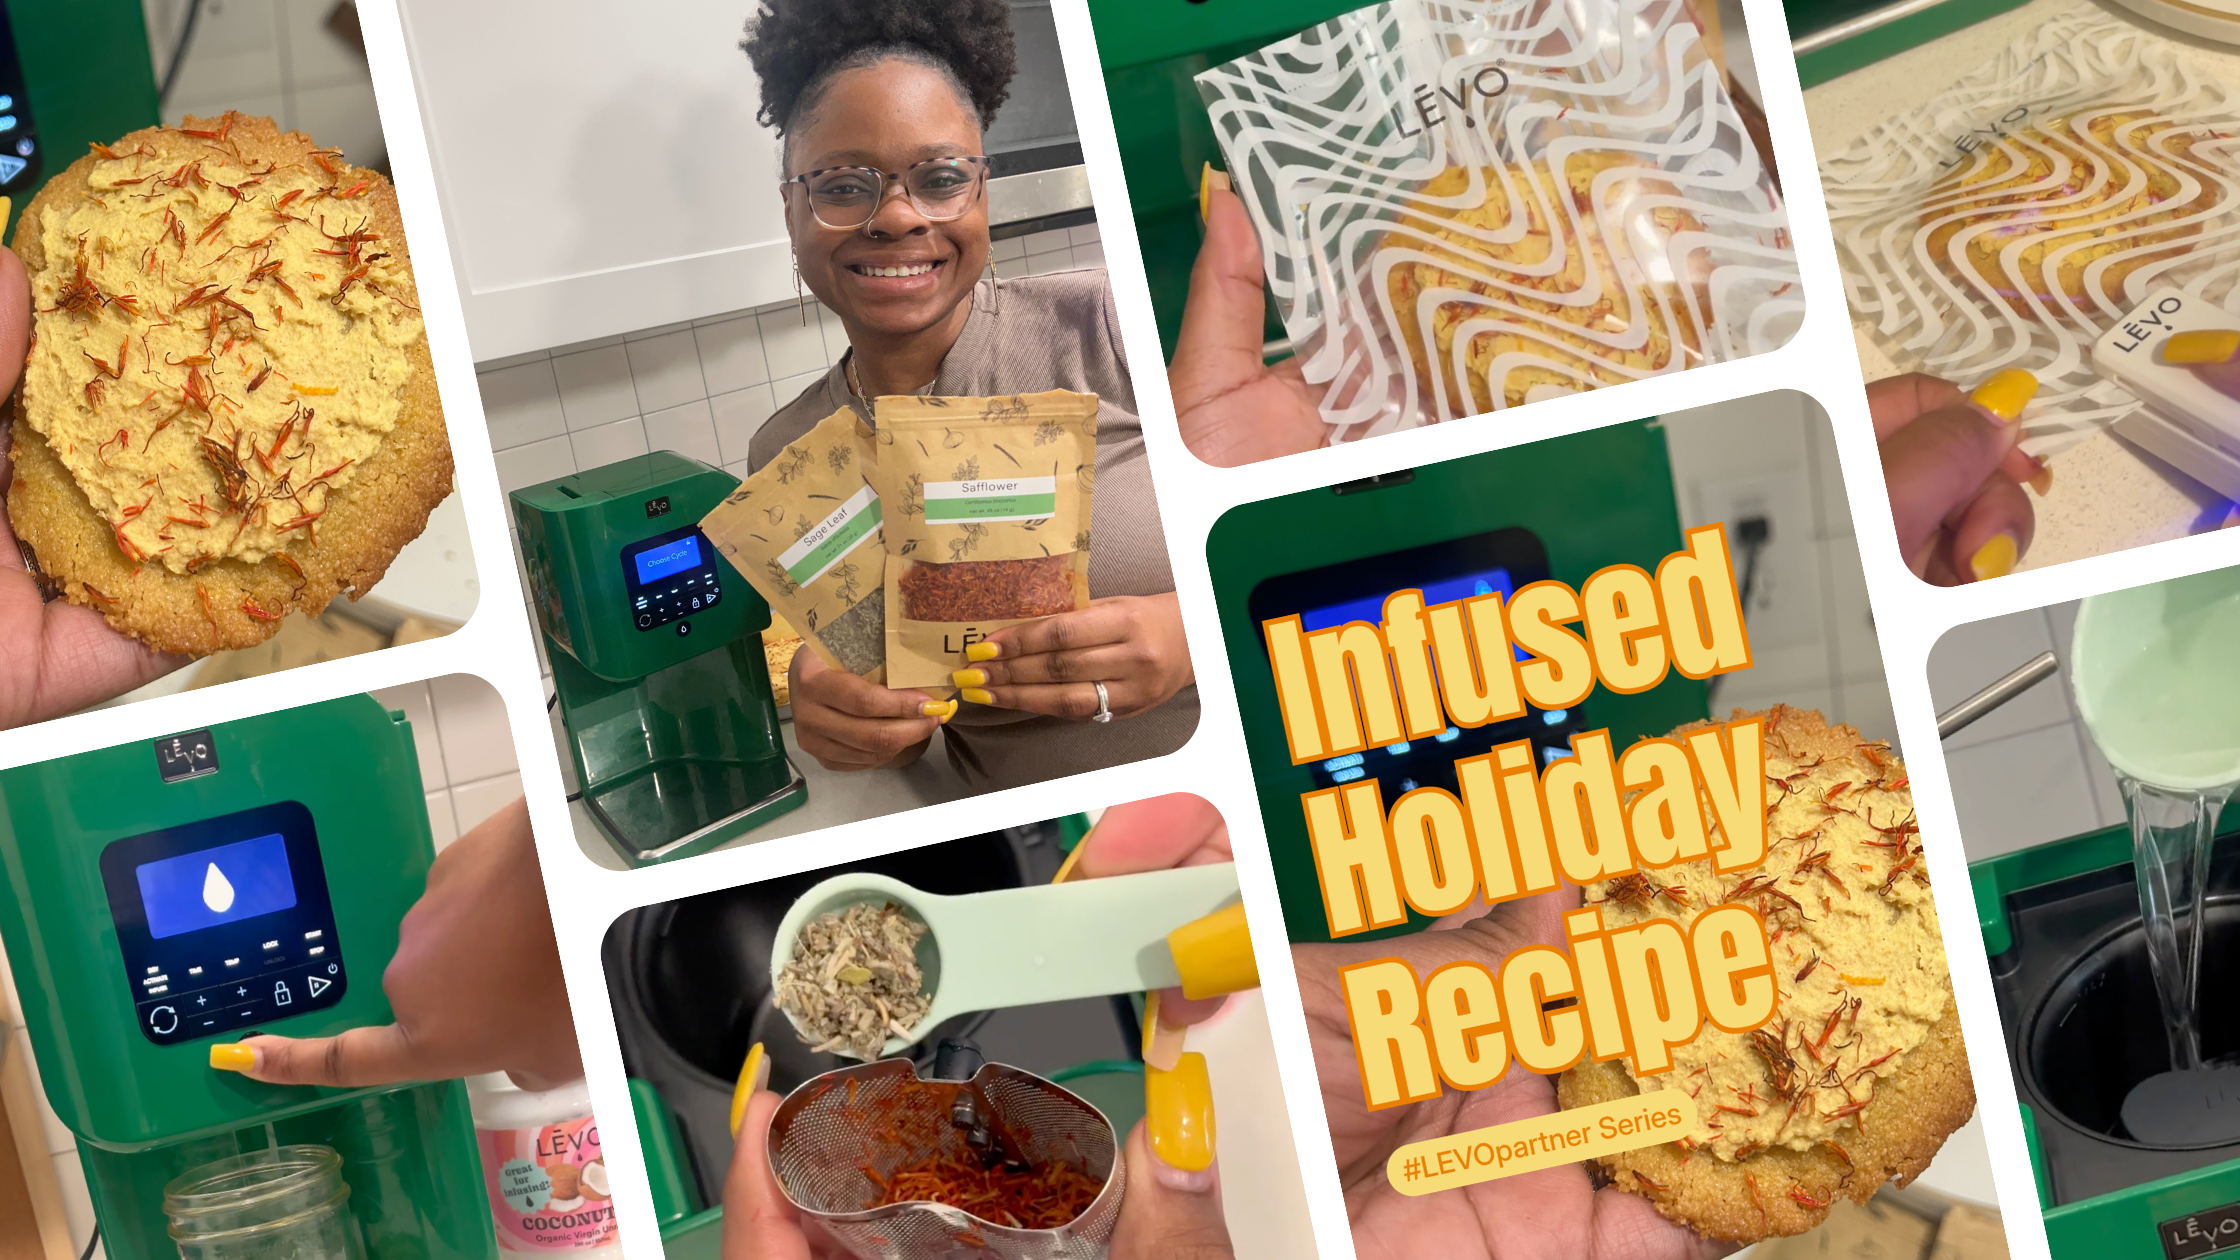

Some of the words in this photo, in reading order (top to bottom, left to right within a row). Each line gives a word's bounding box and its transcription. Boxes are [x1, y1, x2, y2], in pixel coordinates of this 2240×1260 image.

[2113, 297, 2181, 353] LĒVO
[961, 482, 1018, 493] Safflower
[803, 526, 828, 547] Sage
[826, 507, 847, 528] Leaf
[647, 556, 670, 567] Choose
[671, 550, 687, 560] Cycle
[944, 628, 987, 653] LĒ
[263, 940, 279, 950] LOCK
[505, 1164, 533, 1177] Great
[513, 1176, 529, 1185] for
[522, 1206, 615, 1231] COCONUT
[536, 1232, 572, 1244] Organic
[574, 1228, 600, 1239] Virgin
